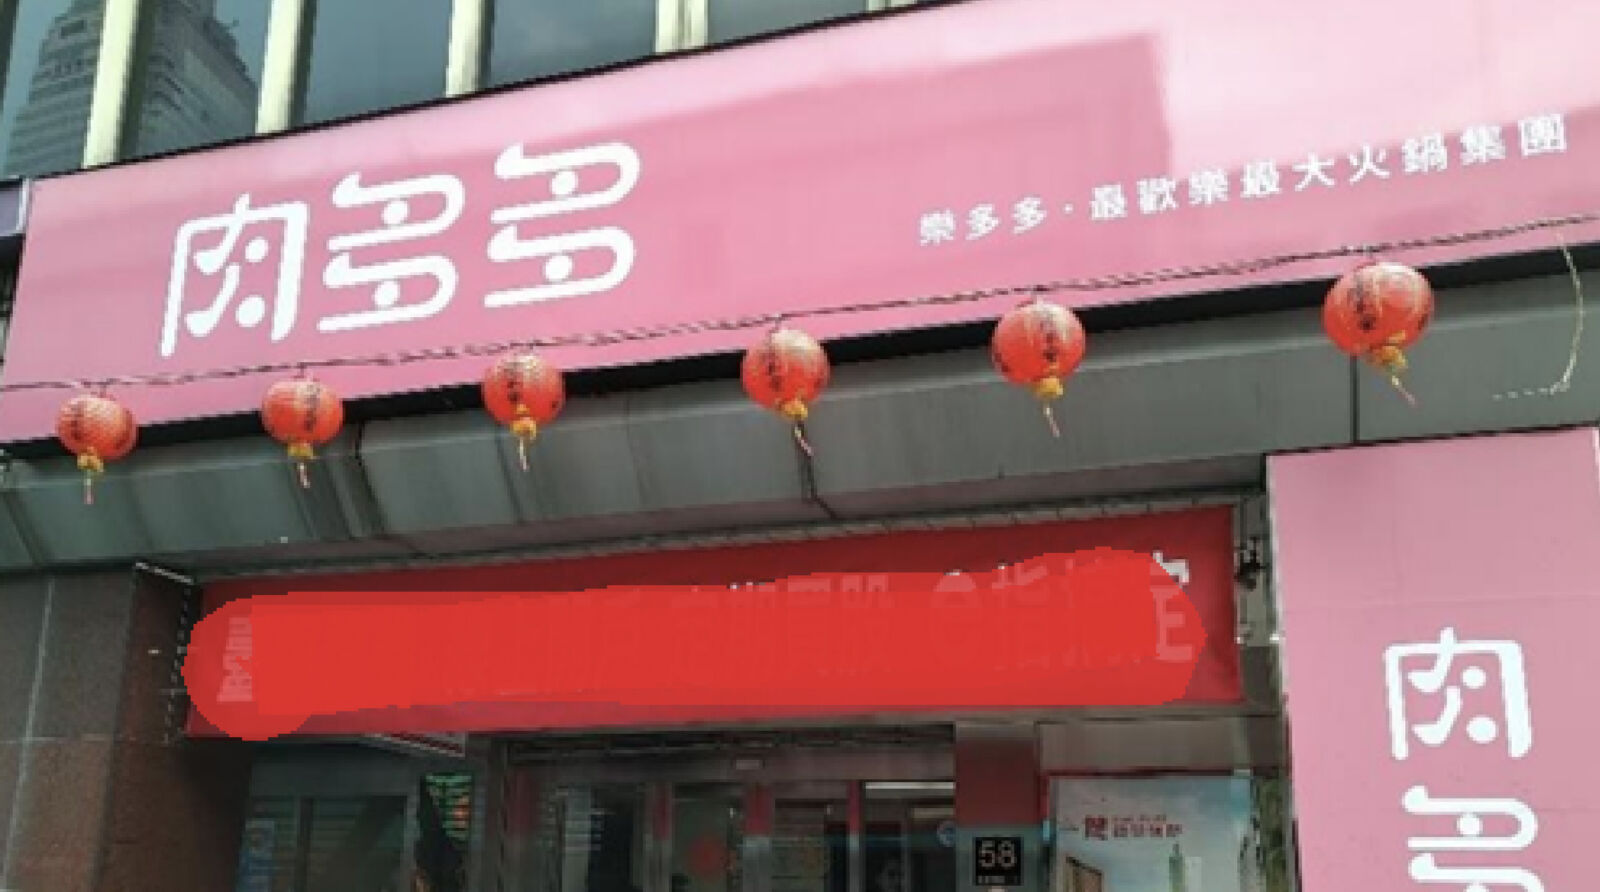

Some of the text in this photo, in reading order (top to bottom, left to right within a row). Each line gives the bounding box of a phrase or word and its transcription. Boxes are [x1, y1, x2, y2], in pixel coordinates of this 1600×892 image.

[160, 142, 641, 357] 肉多多
[979, 840, 1017, 867] 58
